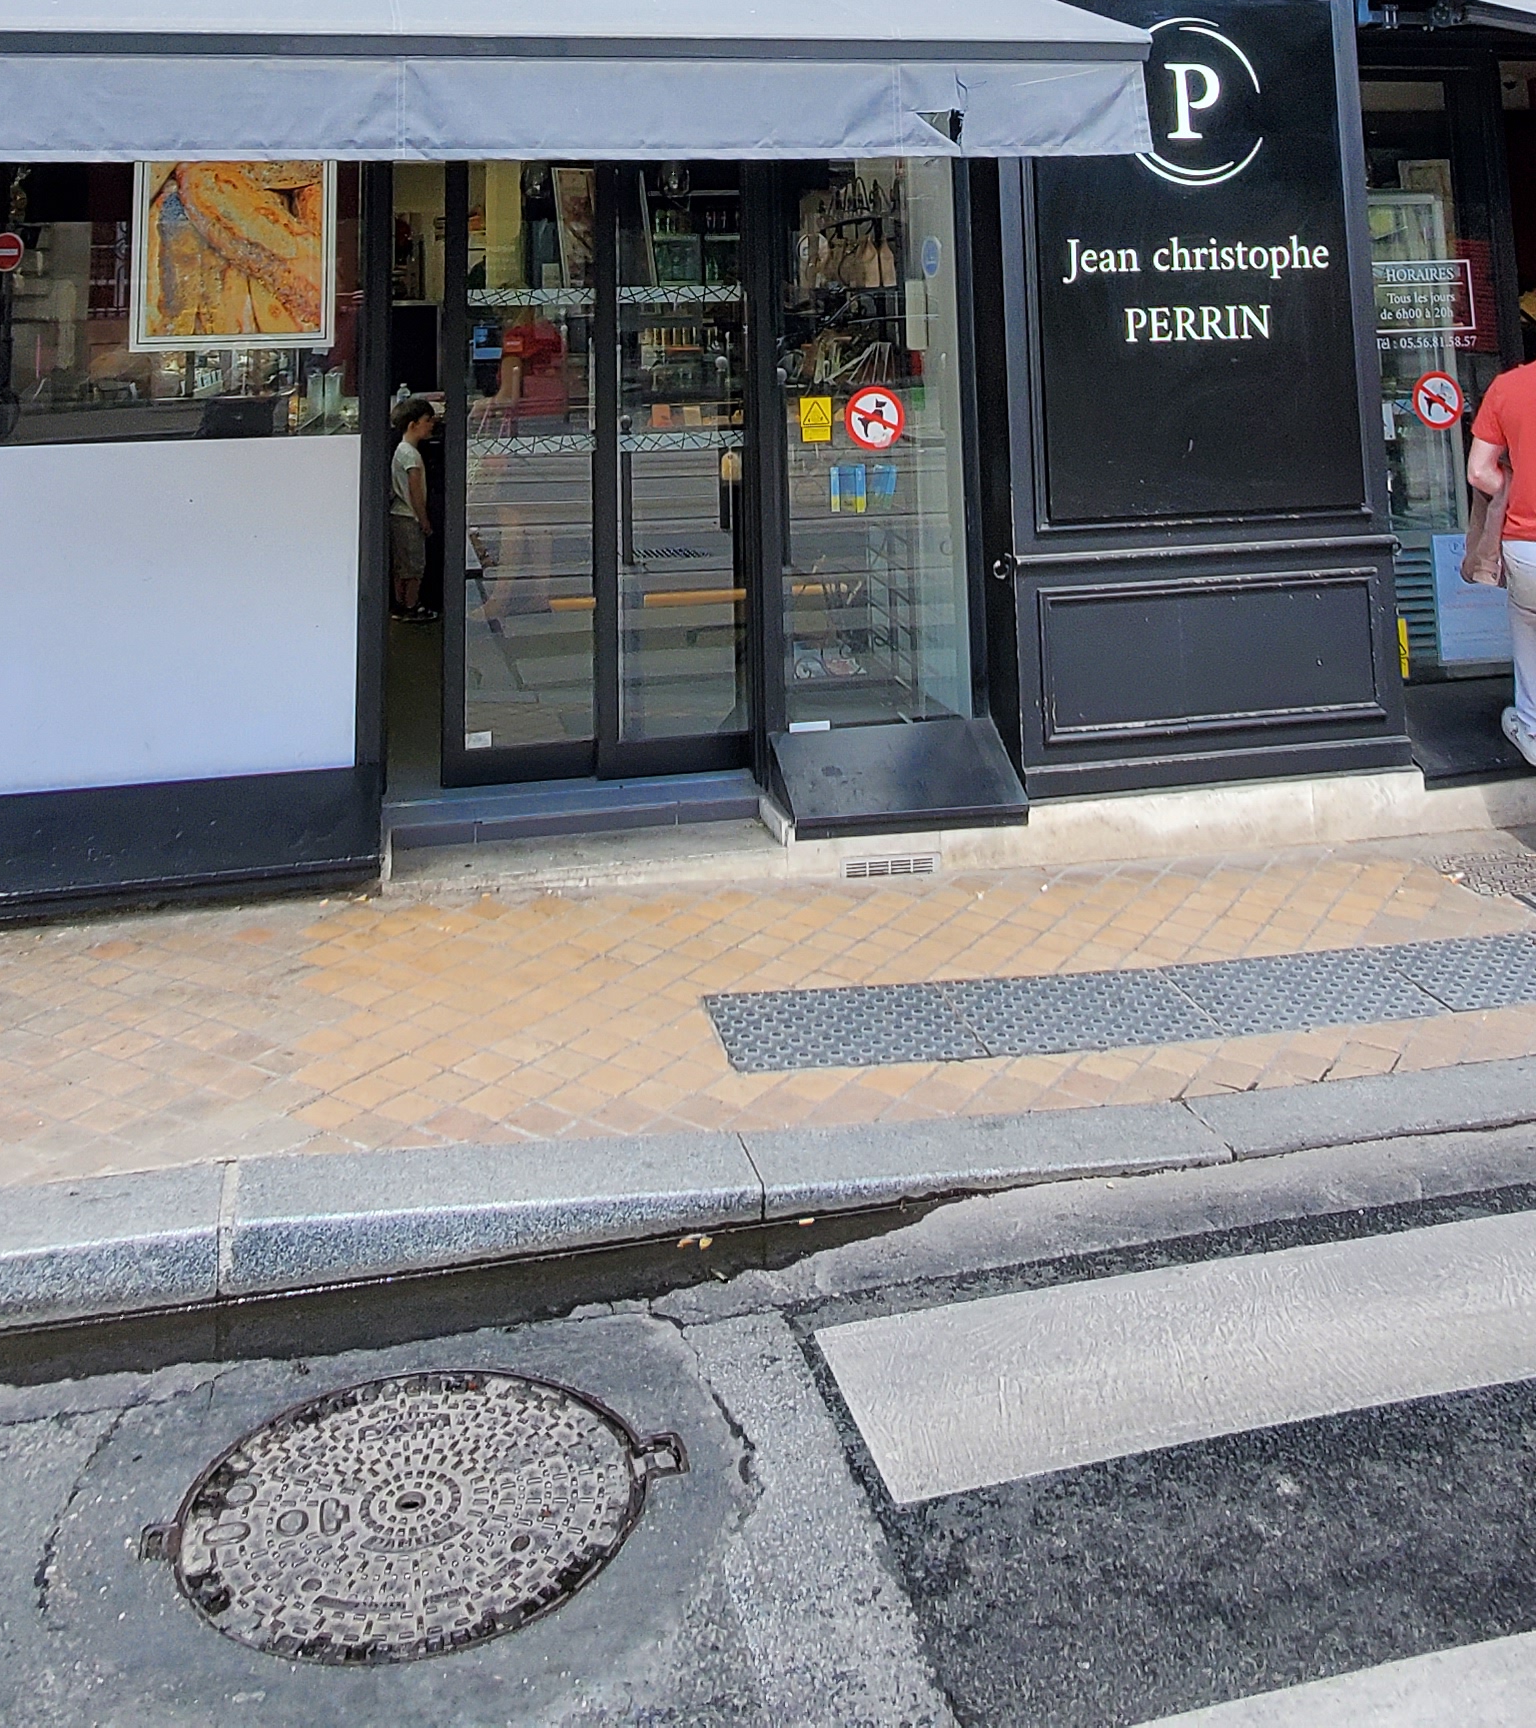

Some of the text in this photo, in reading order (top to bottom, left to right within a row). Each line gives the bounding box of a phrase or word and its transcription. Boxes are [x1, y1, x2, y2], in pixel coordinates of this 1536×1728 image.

[1164, 62, 1221, 140] P
[1062, 235, 1330, 284] Jean christophe
[1385, 267, 1455, 282] HORAIRES
[1386, 291, 1457, 306] Tous les jours
[1380, 308, 1394, 321] de
[1395, 307, 1422, 320] 6h00
[1434, 306, 1454, 319] 20h
[1124, 304, 1271, 343] PERRIN
[1399, 335, 1477, 349] 05.56.81.58.57
